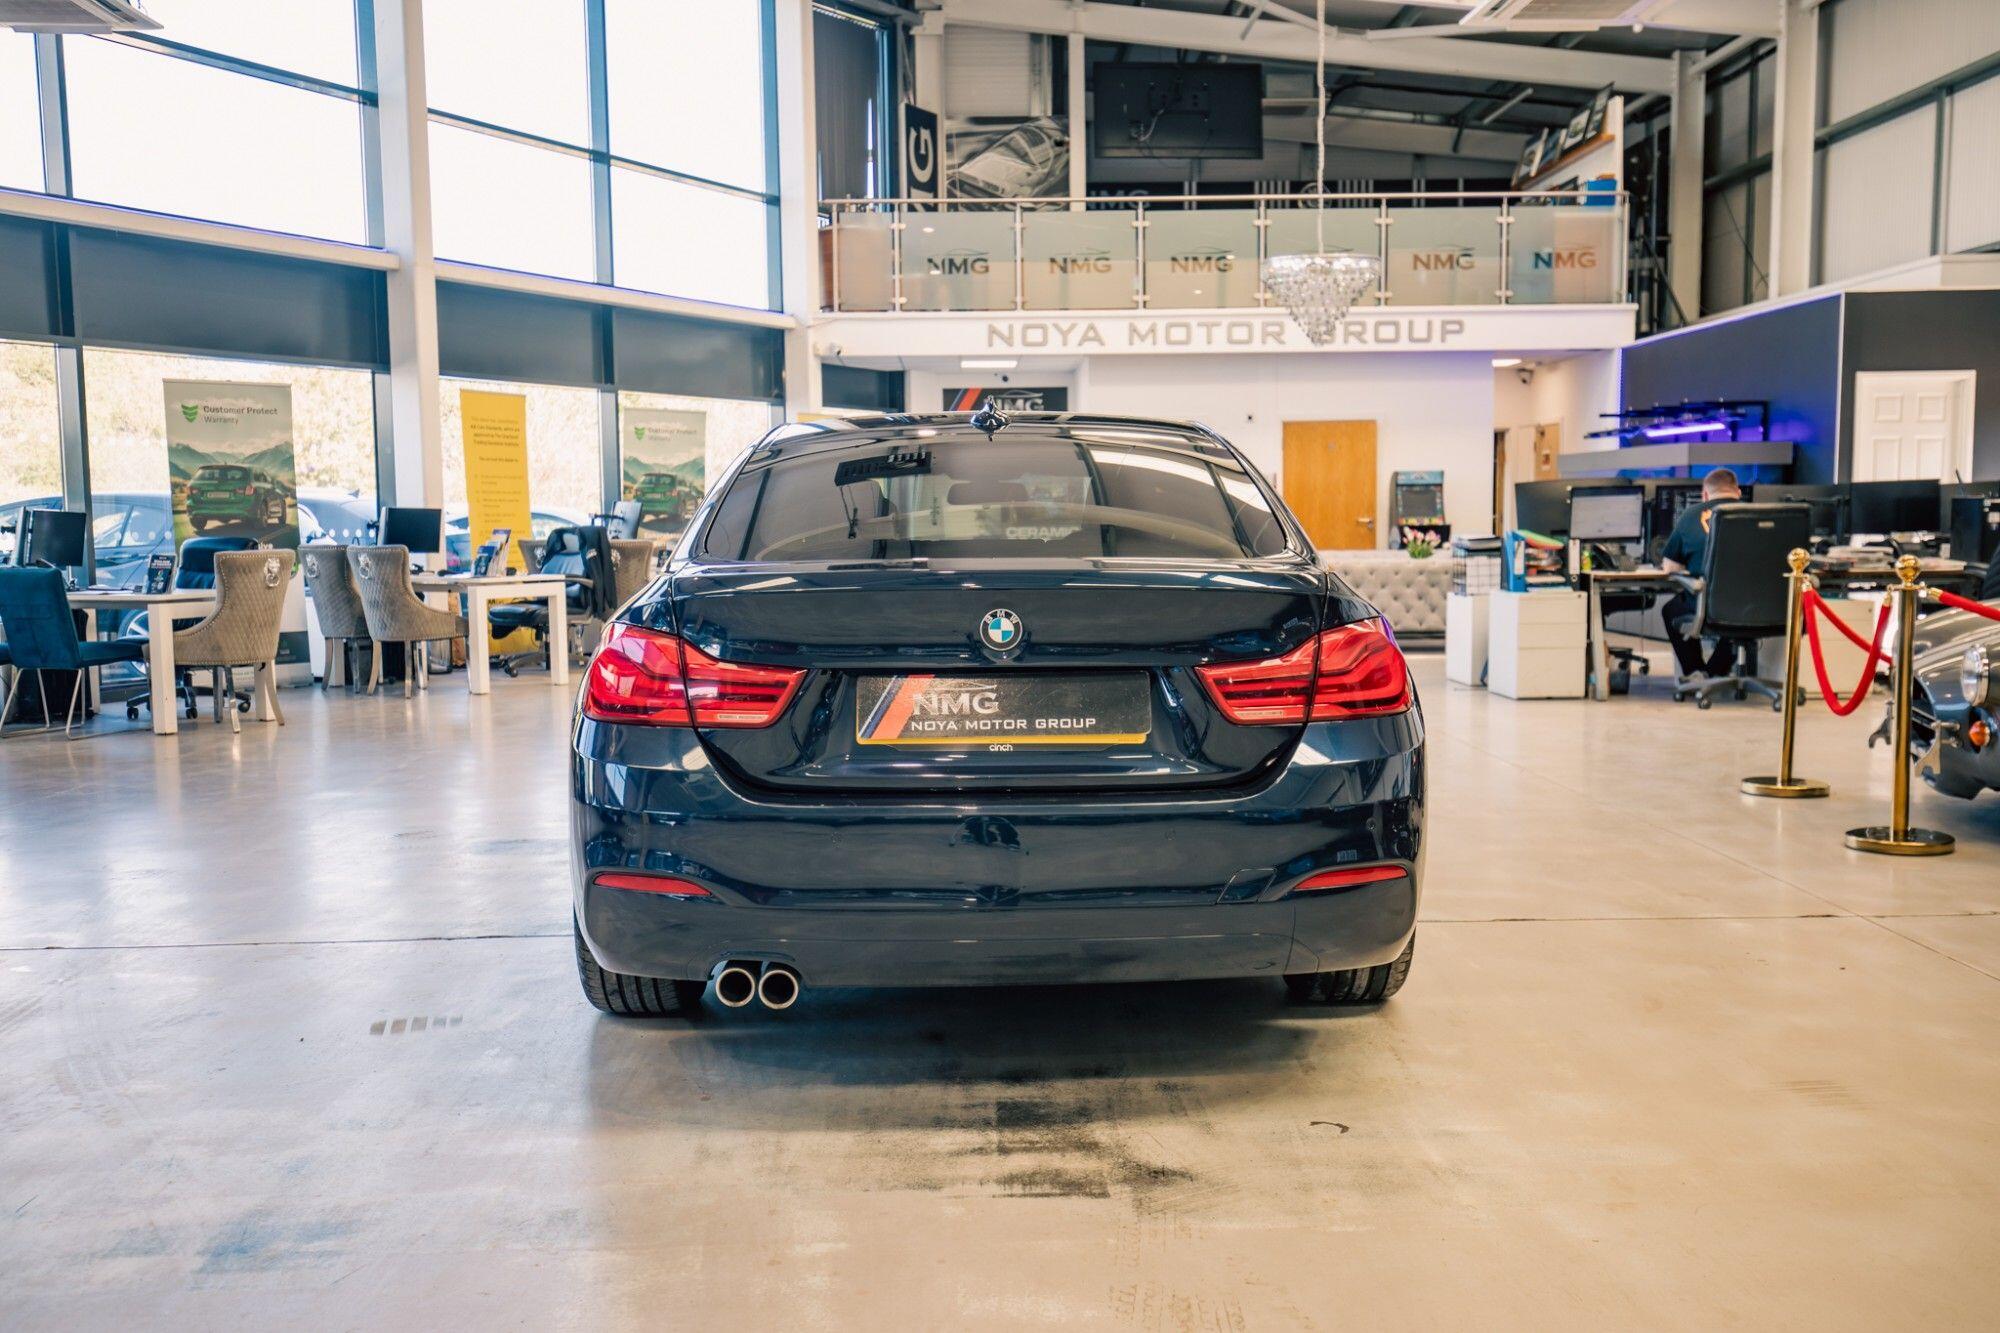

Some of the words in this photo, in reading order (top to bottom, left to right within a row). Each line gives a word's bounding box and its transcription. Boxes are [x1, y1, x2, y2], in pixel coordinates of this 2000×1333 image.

[926, 257, 990, 274] NMG
[1049, 257, 1112, 274] NMG
[1170, 256, 1234, 272] NMG
[1412, 253, 1475, 270] NMG
[1534, 251, 1597, 269] NMG
[987, 322, 1106, 347] NOYA
[1128, 320, 1286, 346] MOTOR
[984, 610, 1020, 624] BMW
[912, 692, 1000, 715] NMG
[911, 720, 958, 731] NOYA
[965, 719, 1028, 730] MOTOR
[1035, 717, 1096, 729] GROUP
[989, 742, 1014, 752] cinch
